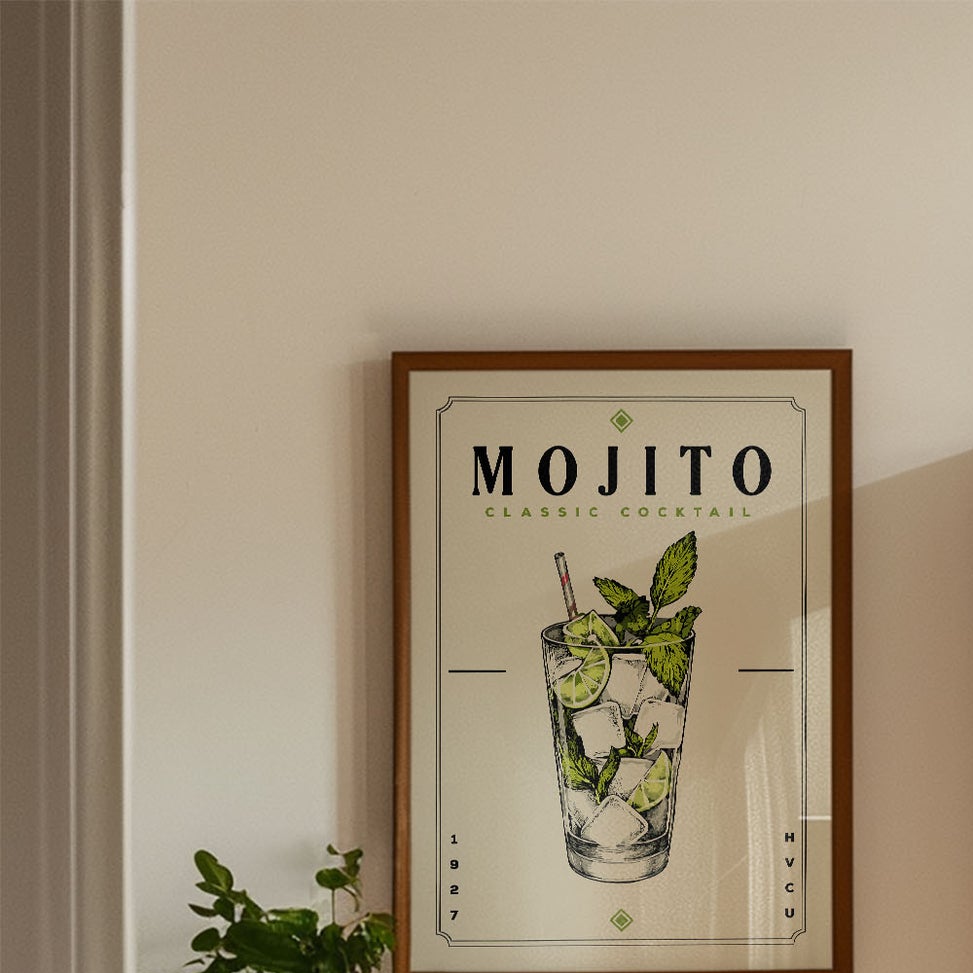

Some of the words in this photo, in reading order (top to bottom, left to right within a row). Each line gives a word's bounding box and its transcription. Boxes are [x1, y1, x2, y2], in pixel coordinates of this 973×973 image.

[471, 445, 772, 497] MOJITO
[484, 506, 599, 518] CLASSIC
[620, 506, 751, 518] COCKTAIL
